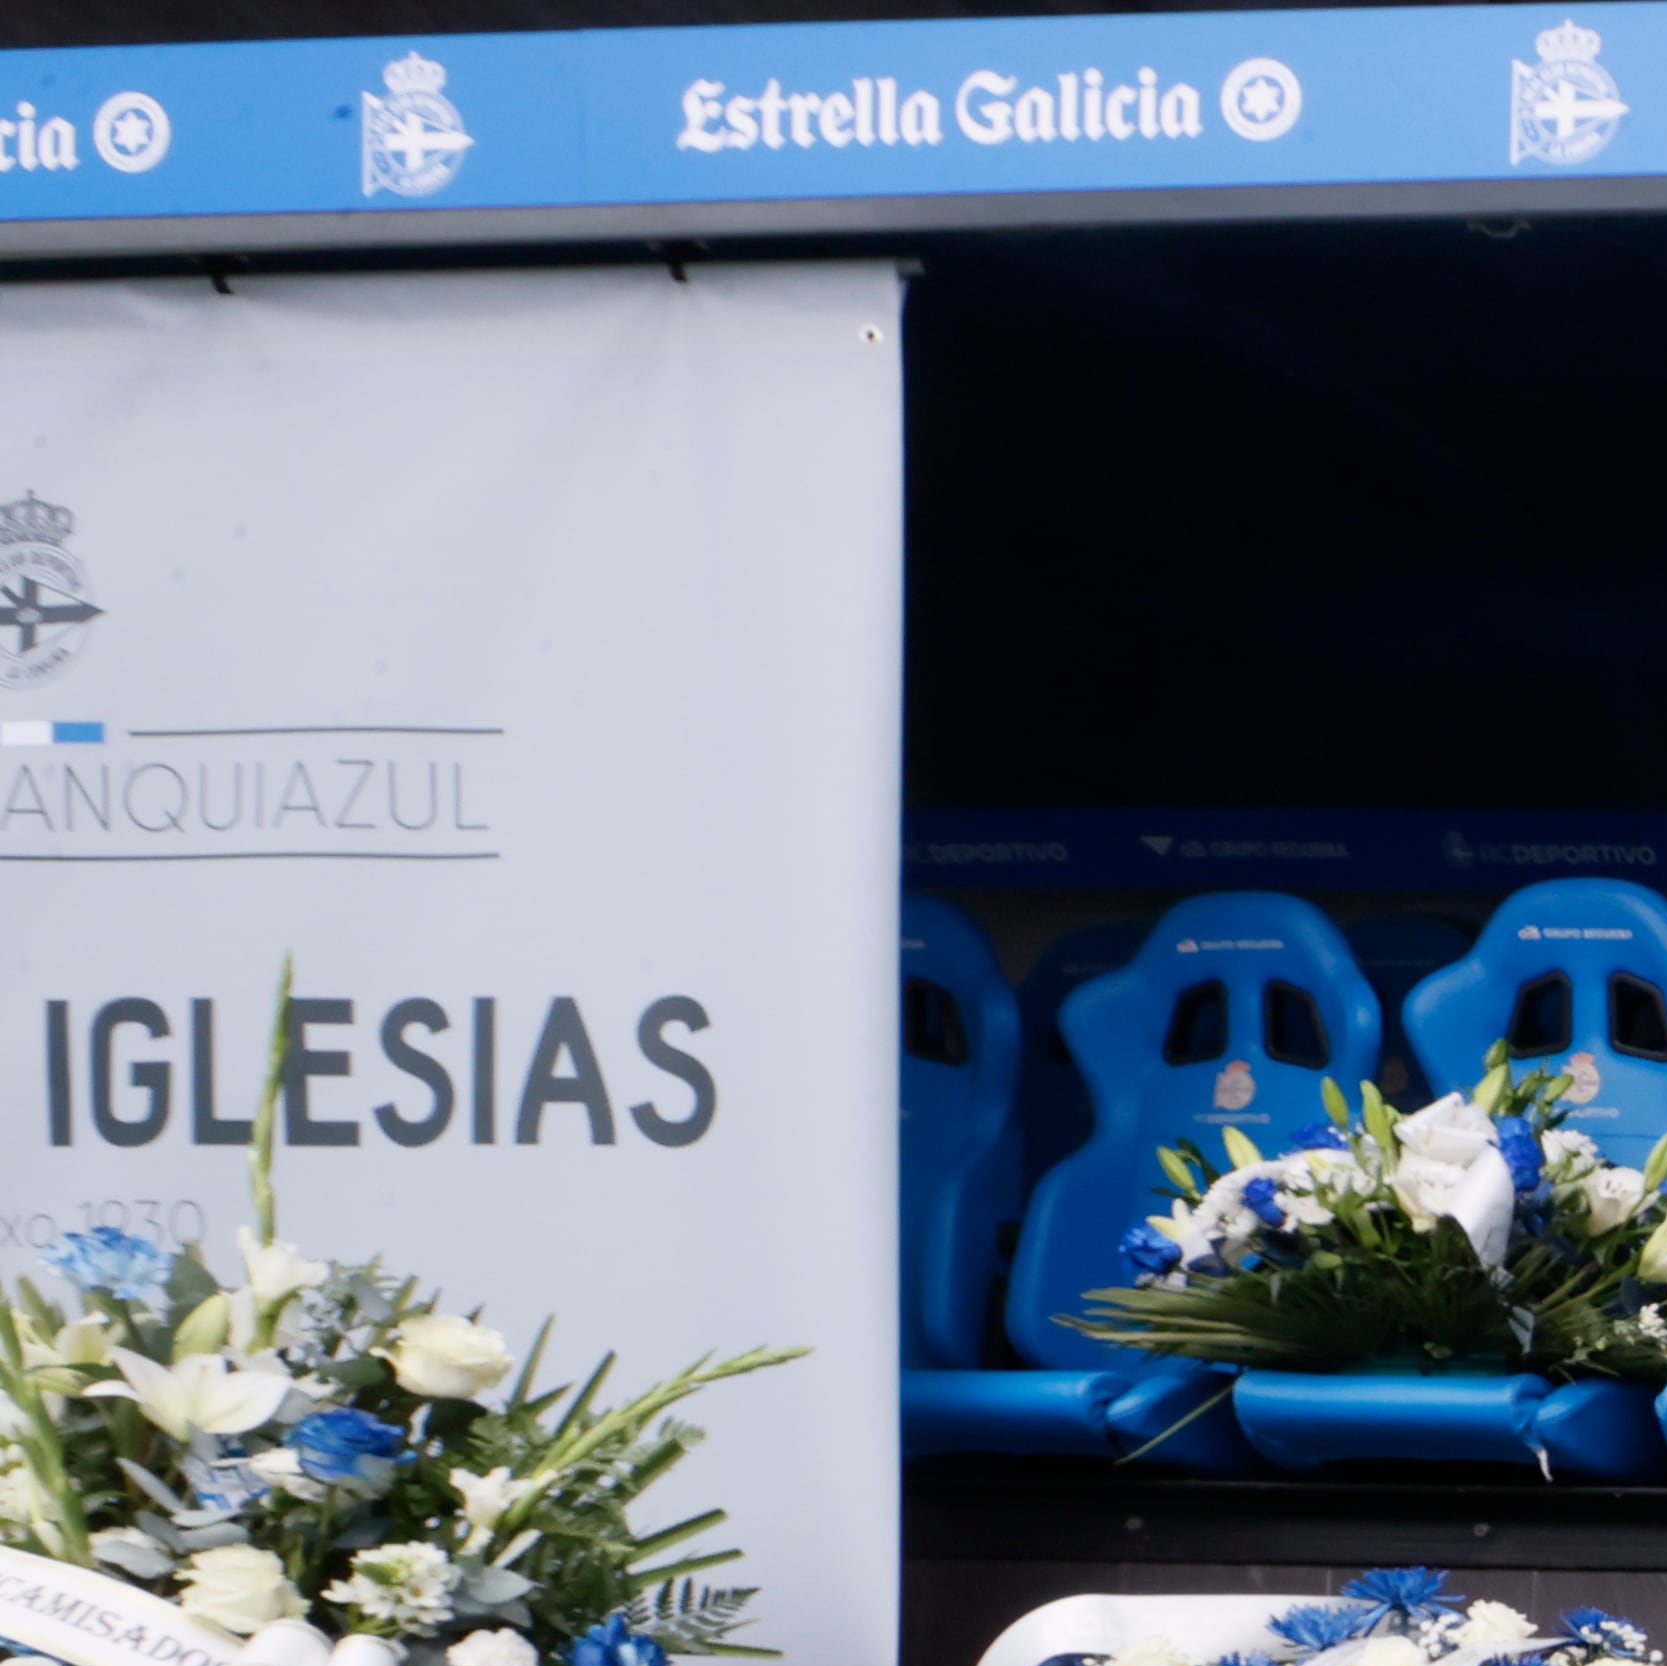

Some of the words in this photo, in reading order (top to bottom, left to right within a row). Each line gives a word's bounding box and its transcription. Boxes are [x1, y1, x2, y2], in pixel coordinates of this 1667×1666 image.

[677, 78, 942, 153] Estrella
[956, 66, 1204, 146] Galicia
[45, 994, 718, 1149] IGLESIAS
